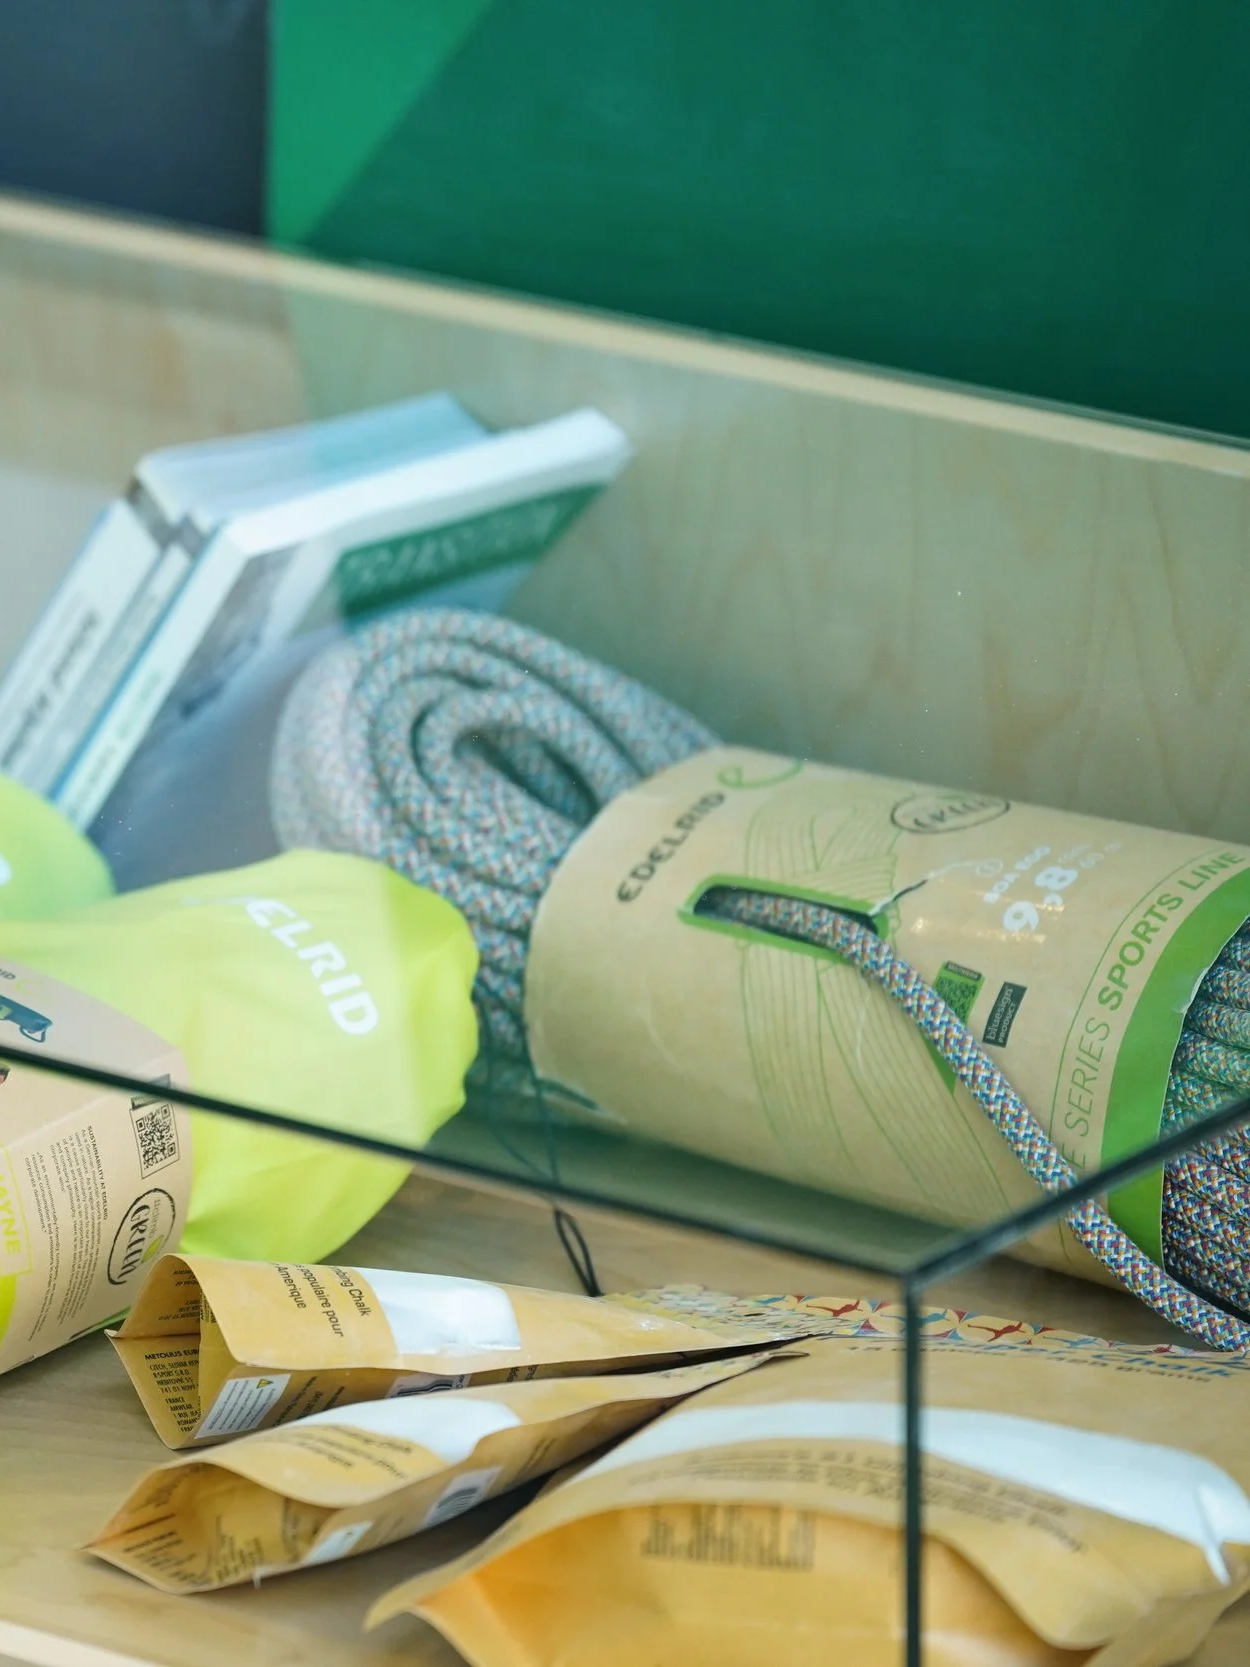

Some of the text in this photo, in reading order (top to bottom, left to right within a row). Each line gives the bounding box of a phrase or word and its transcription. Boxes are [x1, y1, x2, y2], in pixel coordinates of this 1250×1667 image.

[617, 791, 725, 902] EDELRID
[1064, 852, 1246, 1137] SERIES SPORTS LINE
[999, 1003, 1016, 1042] PRODUCT
[55, 1142, 63, 1154] and
[74, 1131, 83, 1147] used
[40, 1164, 46, 1173] an
[48, 1143, 62, 1175] corporate
[58, 1154, 71, 1183] company
[63, 1145, 74, 1168] people
[84, 1143, 95, 1169] German
[90, 1170, 101, 1199] mountain
[87, 1125, 104, 1180] SUSTAINABILITY
[99, 1181, 106, 1190] AT
[23, 1156, 37, 1188] corporate
[69, 1168, 77, 1181] and
[70, 1147, 80, 1166] cause
[75, 1167, 87, 1202] particularly
[85, 1177, 91, 1185] As
[30, 1153, 42, 1181] resource
[36, 1181, 52, 1222] consumption
[72, 1182, 81, 1202] nature
[86, 1191, 95, 1210] logical
[77, 1210, 83, 1218] an
[301, 1268, 344, 1337] populaire pour
[349, 1288, 371, 1317] Chalk
[145, 1348, 200, 1361] METOLIUS EUR
[165, 1396, 185, 1404] FRANCE
